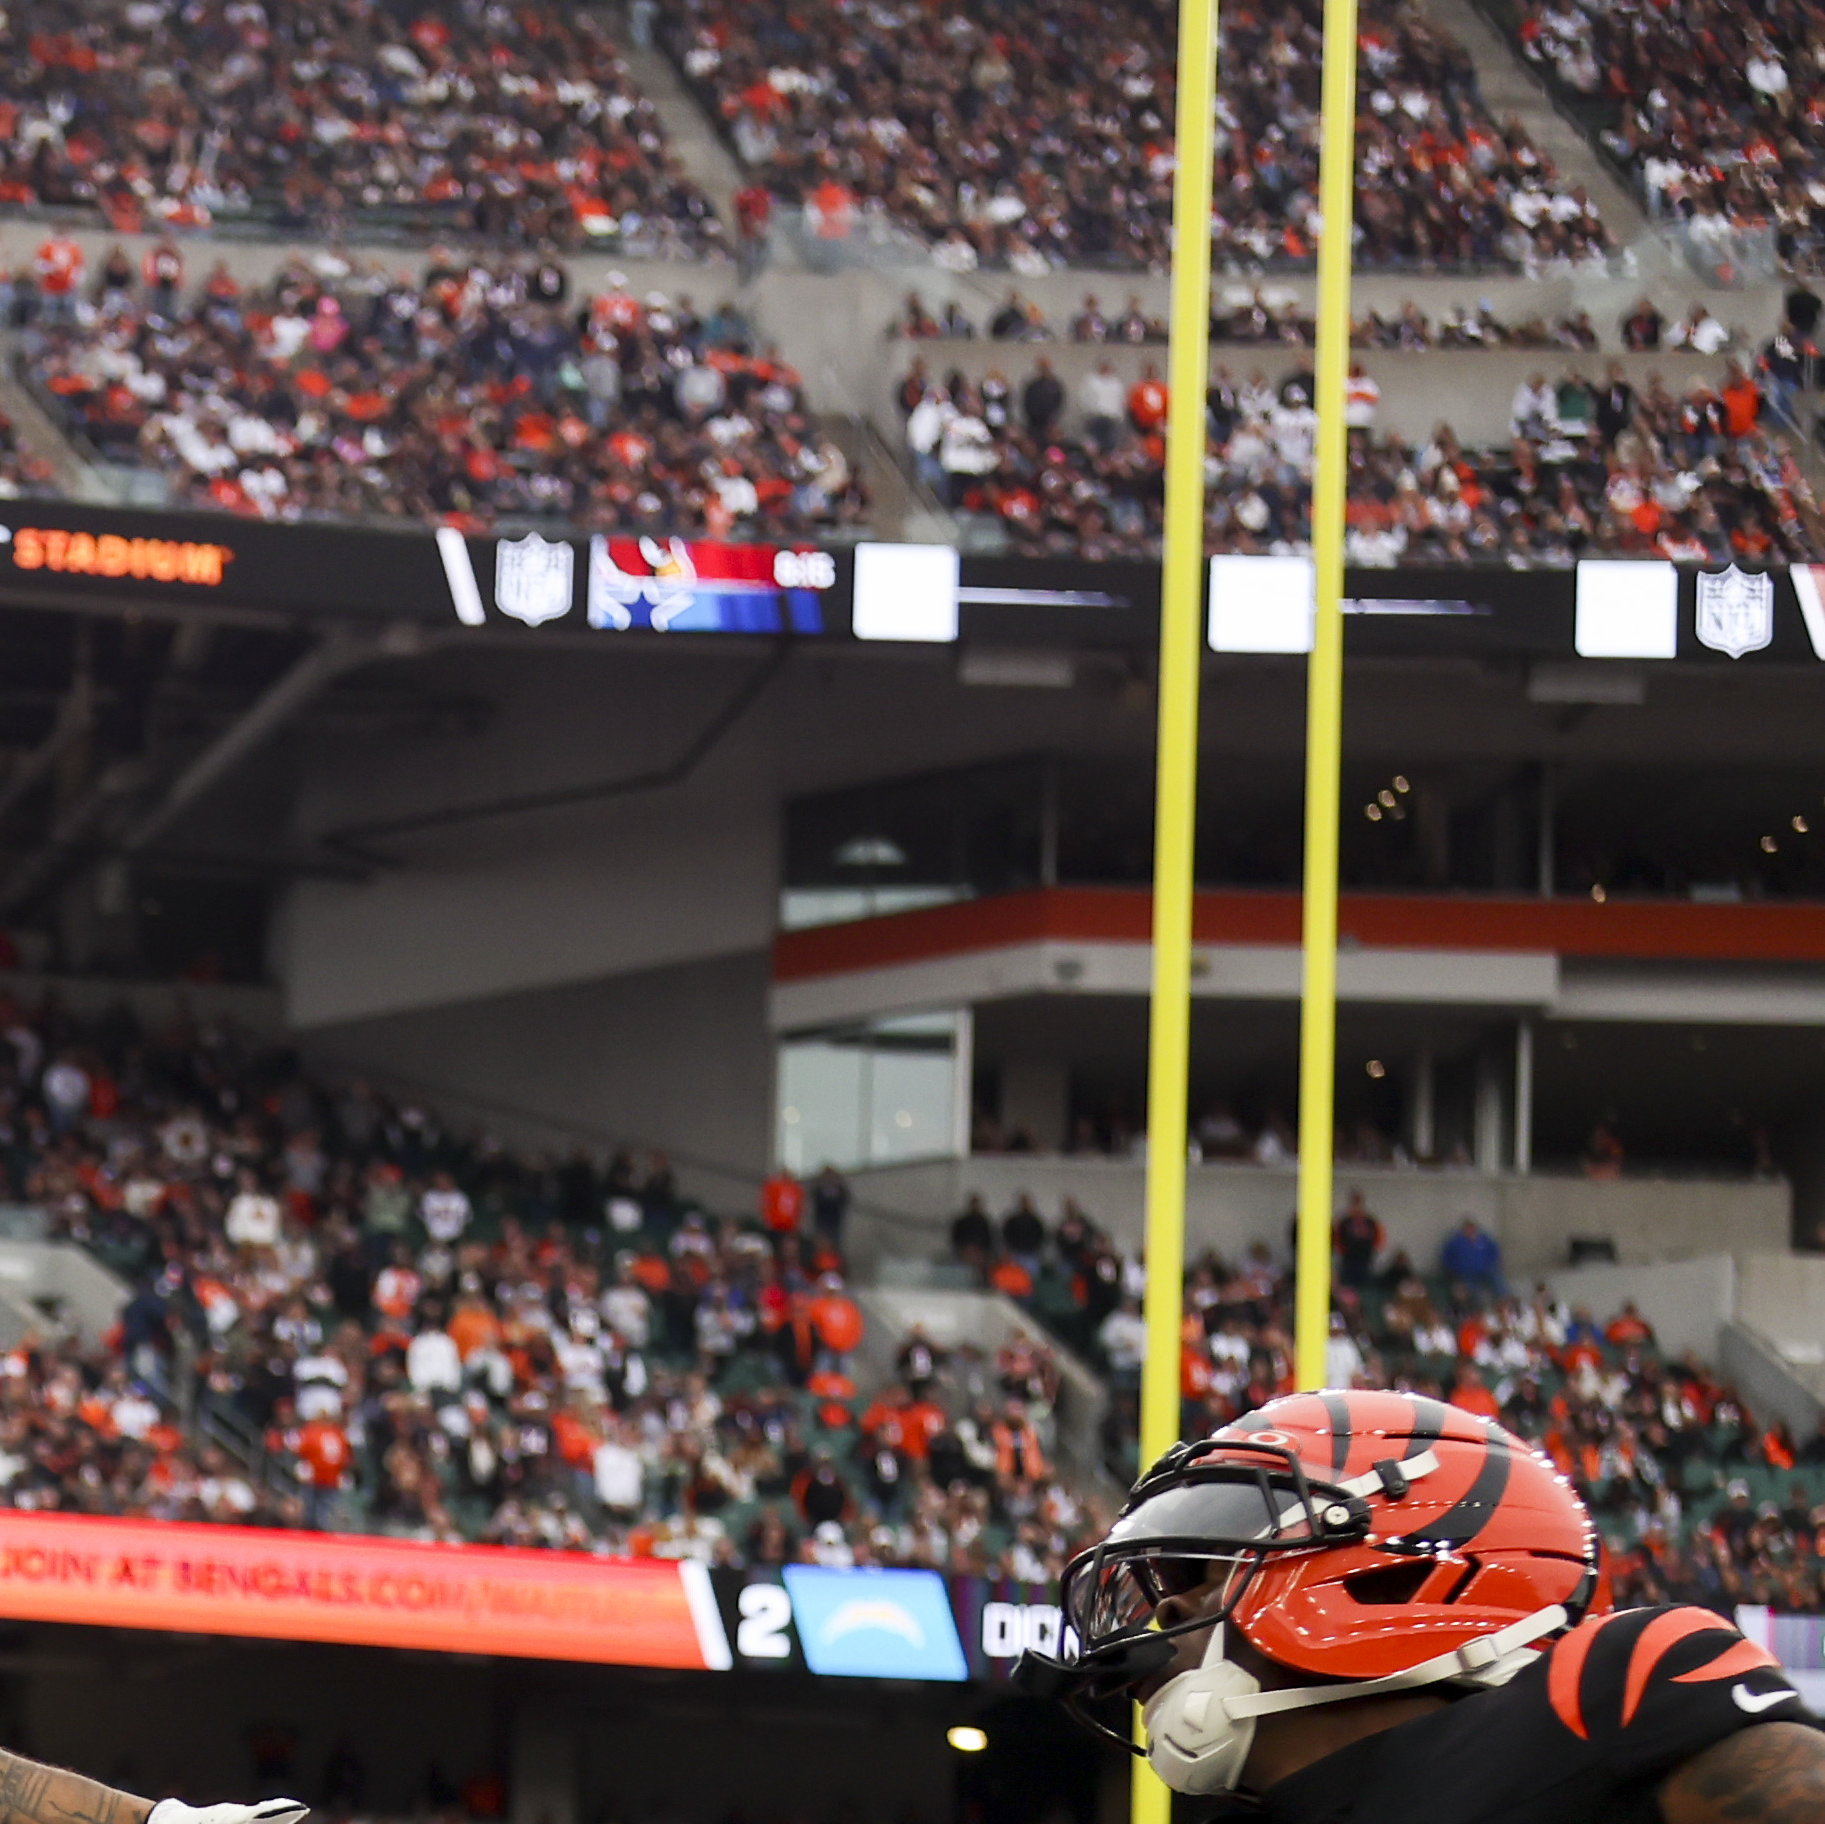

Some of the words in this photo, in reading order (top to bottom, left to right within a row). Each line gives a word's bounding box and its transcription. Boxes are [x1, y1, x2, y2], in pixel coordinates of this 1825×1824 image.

[12, 527, 225, 587] STADIUM
[0, 1547, 97, 1585] JOIN
[113, 1554, 162, 1588] AT
[736, 1584, 792, 1660] 2
